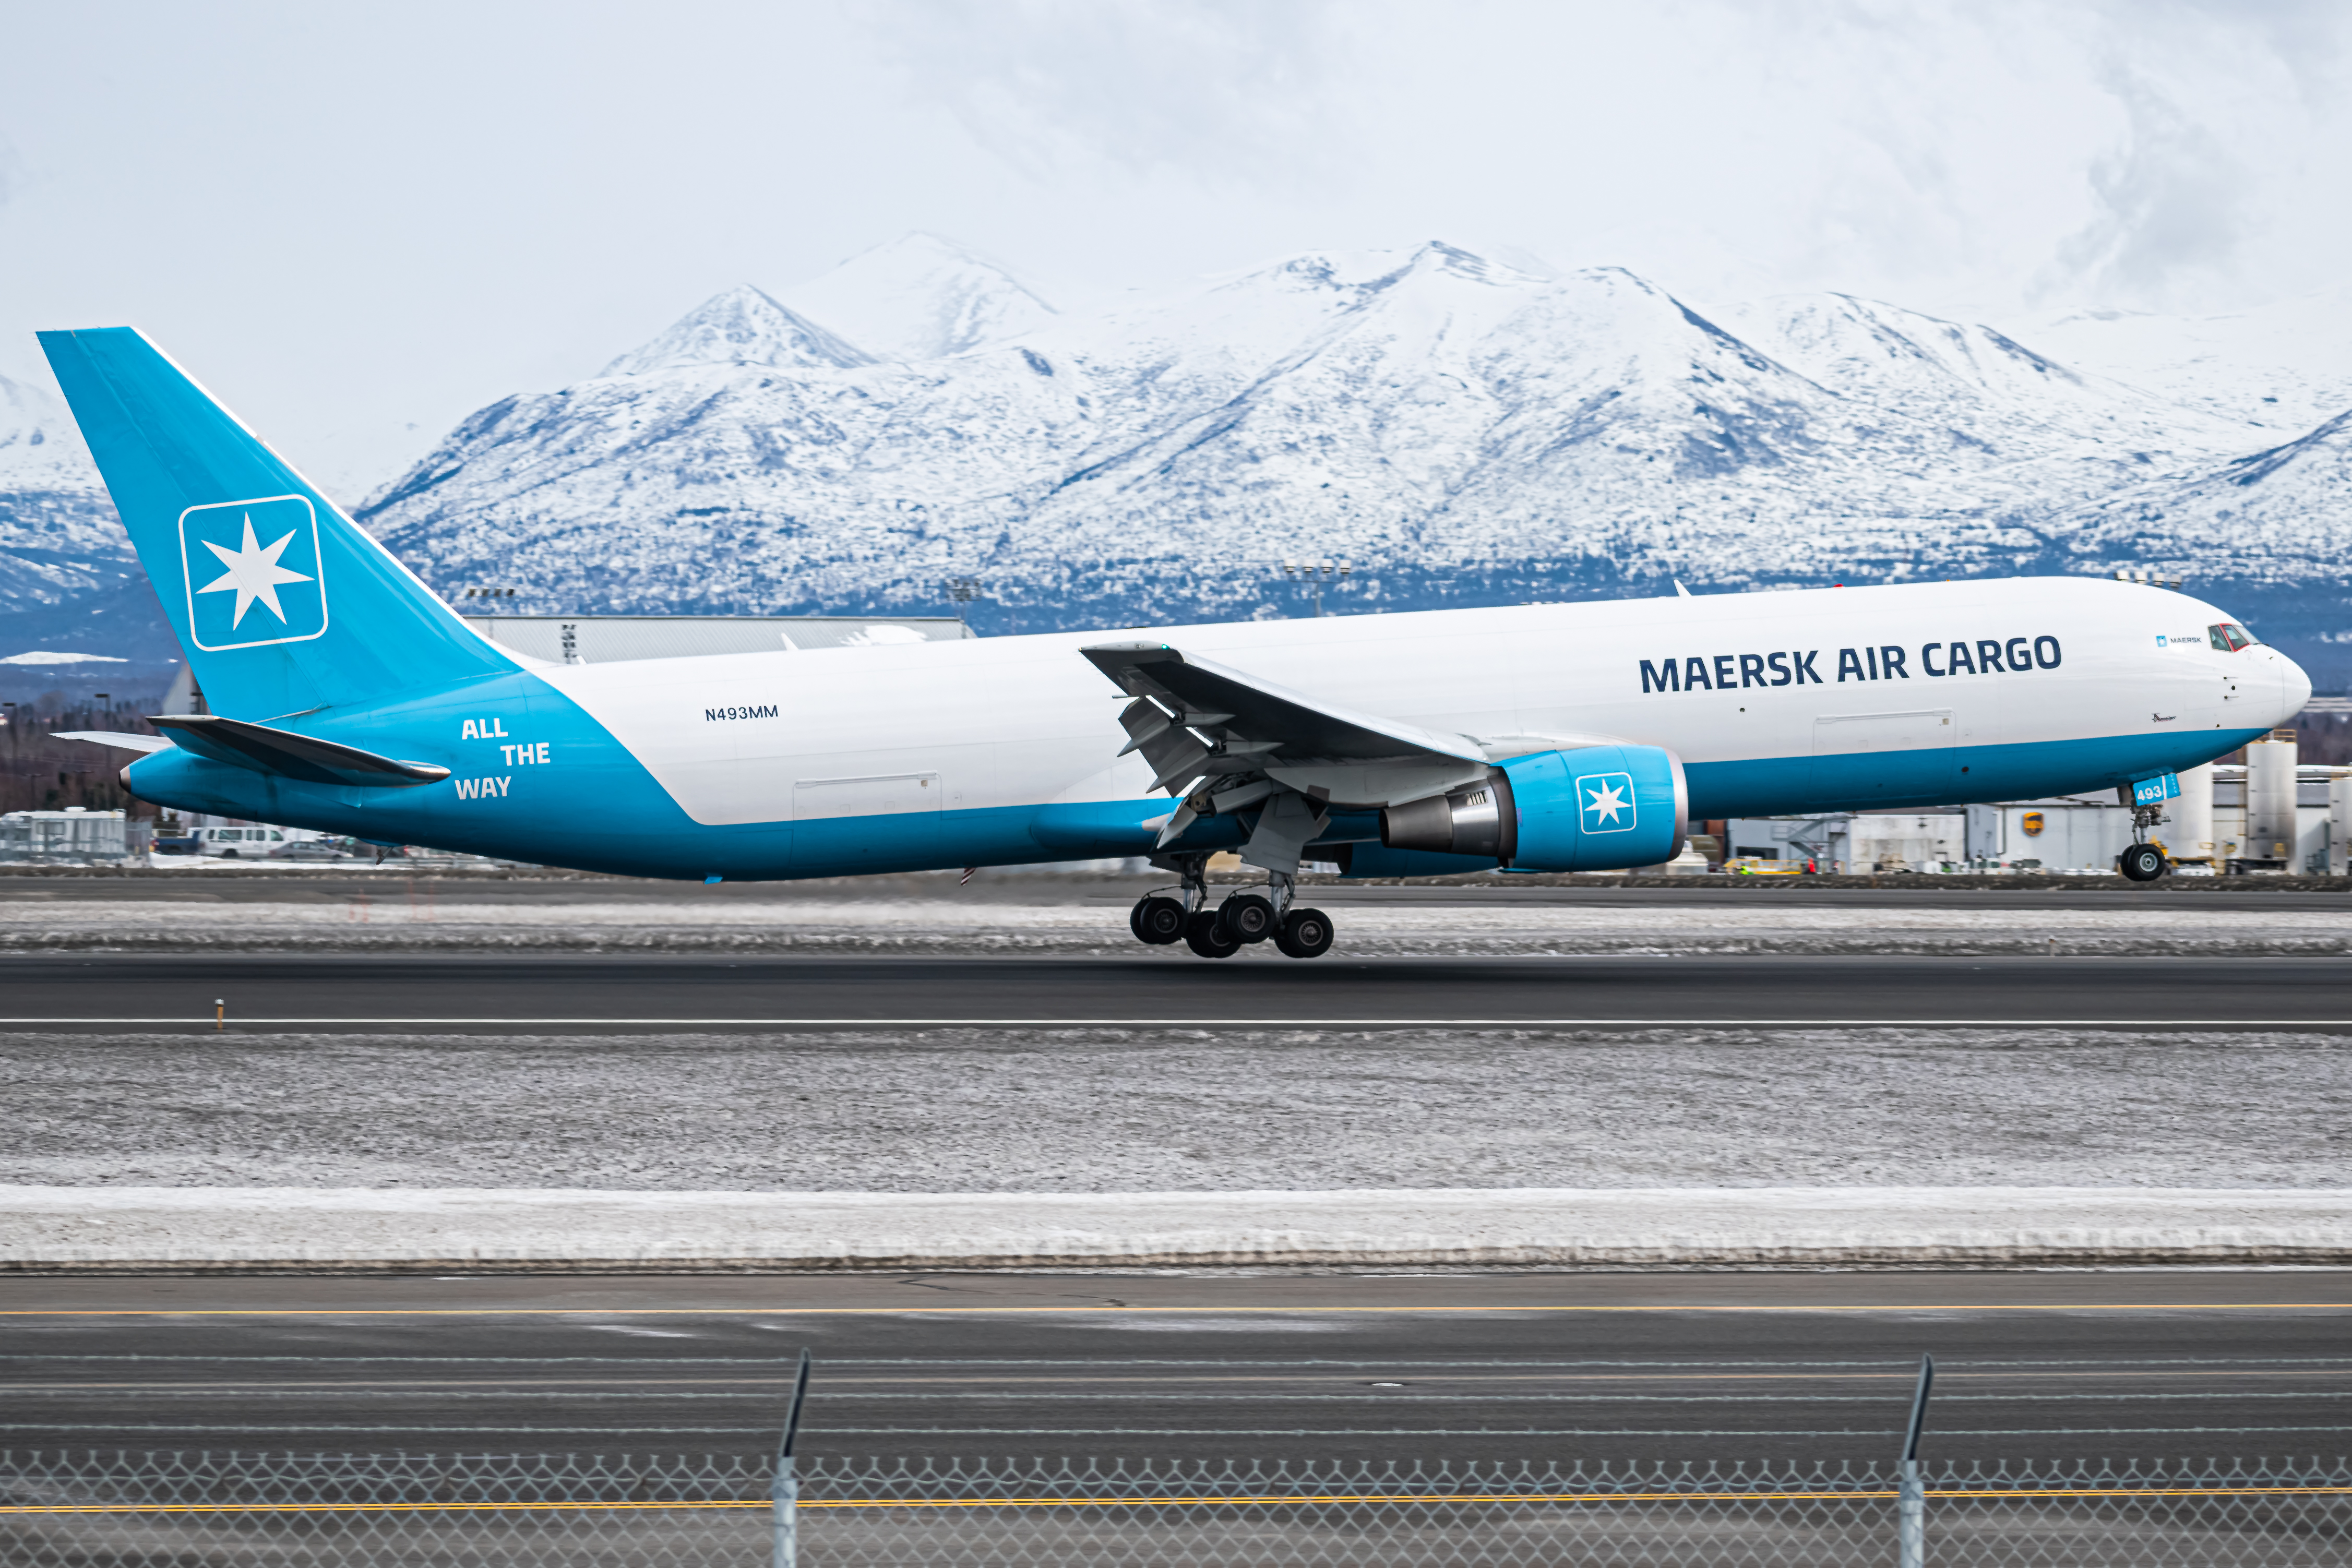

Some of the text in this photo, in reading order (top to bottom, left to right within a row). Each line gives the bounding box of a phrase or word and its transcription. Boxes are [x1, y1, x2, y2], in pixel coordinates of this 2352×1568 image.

[1639, 635, 2061, 693] MAERSK AIR CARGO
[705, 705, 779, 722] N493MM
[462, 718, 509, 740] ALL
[500, 742, 551, 766] THE
[455, 776, 511, 800] WAY
[2138, 785, 2162, 801] 493
